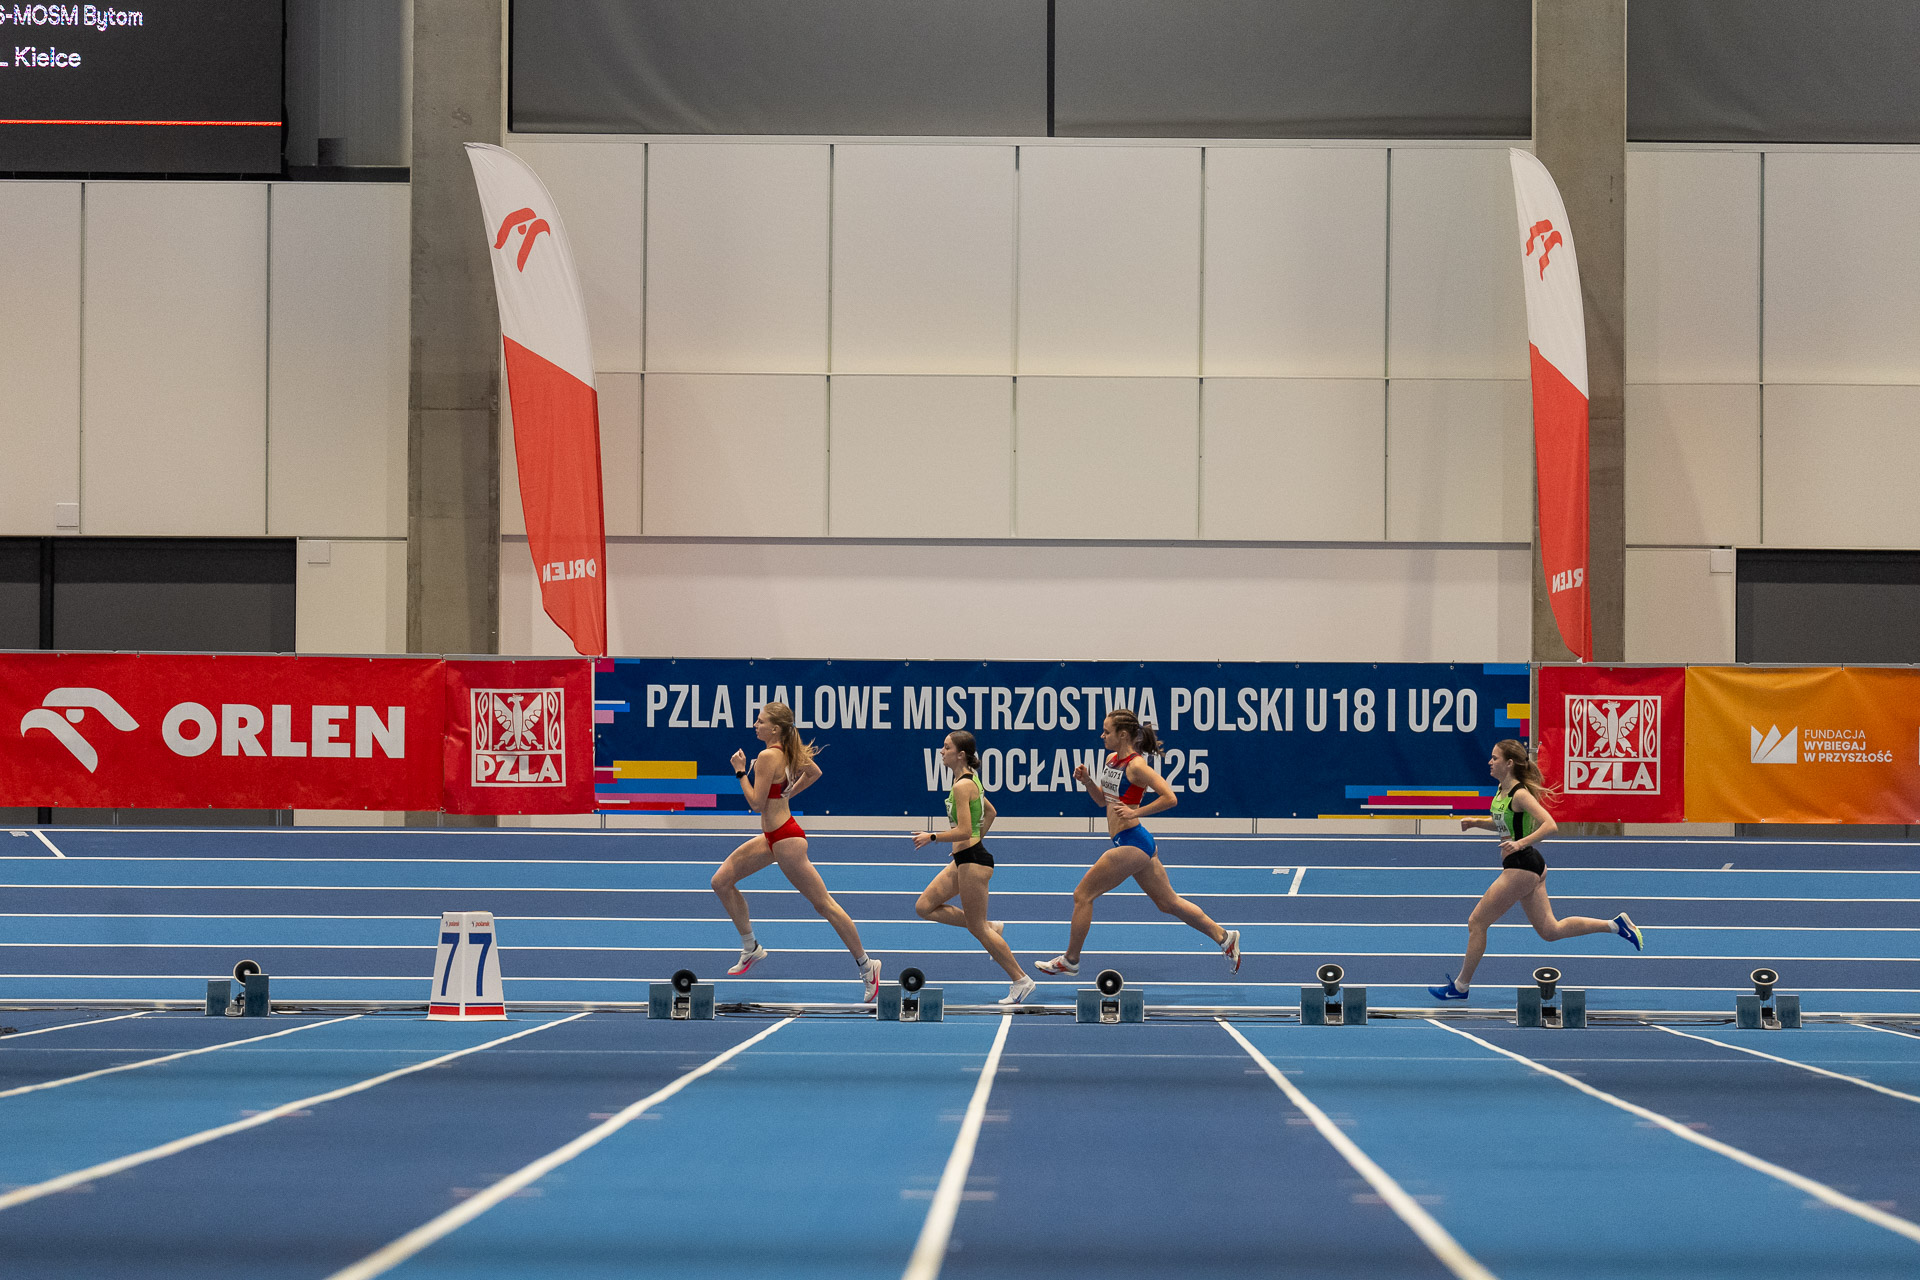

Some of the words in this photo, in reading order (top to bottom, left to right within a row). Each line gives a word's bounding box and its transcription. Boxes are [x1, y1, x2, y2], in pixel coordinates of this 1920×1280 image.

[83, 4, 144, 32] Bytom
[14, 46, 82, 68] Kielce
[646, 684, 734, 728] PZLA
[903, 686, 1159, 731] MISTRZOSTWA
[1170, 686, 1294, 732] POLSKI
[1306, 687, 1376, 732] U18
[1387, 688, 1396, 732] I
[1408, 688, 1478, 733] U20
[161, 701, 405, 759] ORLEN
[1804, 729, 1866, 739] FUNDACJA
[1803, 752, 1816, 762] W
[1818, 750, 1893, 763] PRZYSZŁOŚĆ
[1804, 741, 1867, 751] WYBIEGAJ
[476, 755, 561, 782] PZLA
[923, 747, 1105, 793] WOCŁAW
[1569, 761, 1654, 790] PZLA
[440, 931, 460, 996] 7
[468, 932, 492, 997] 7
